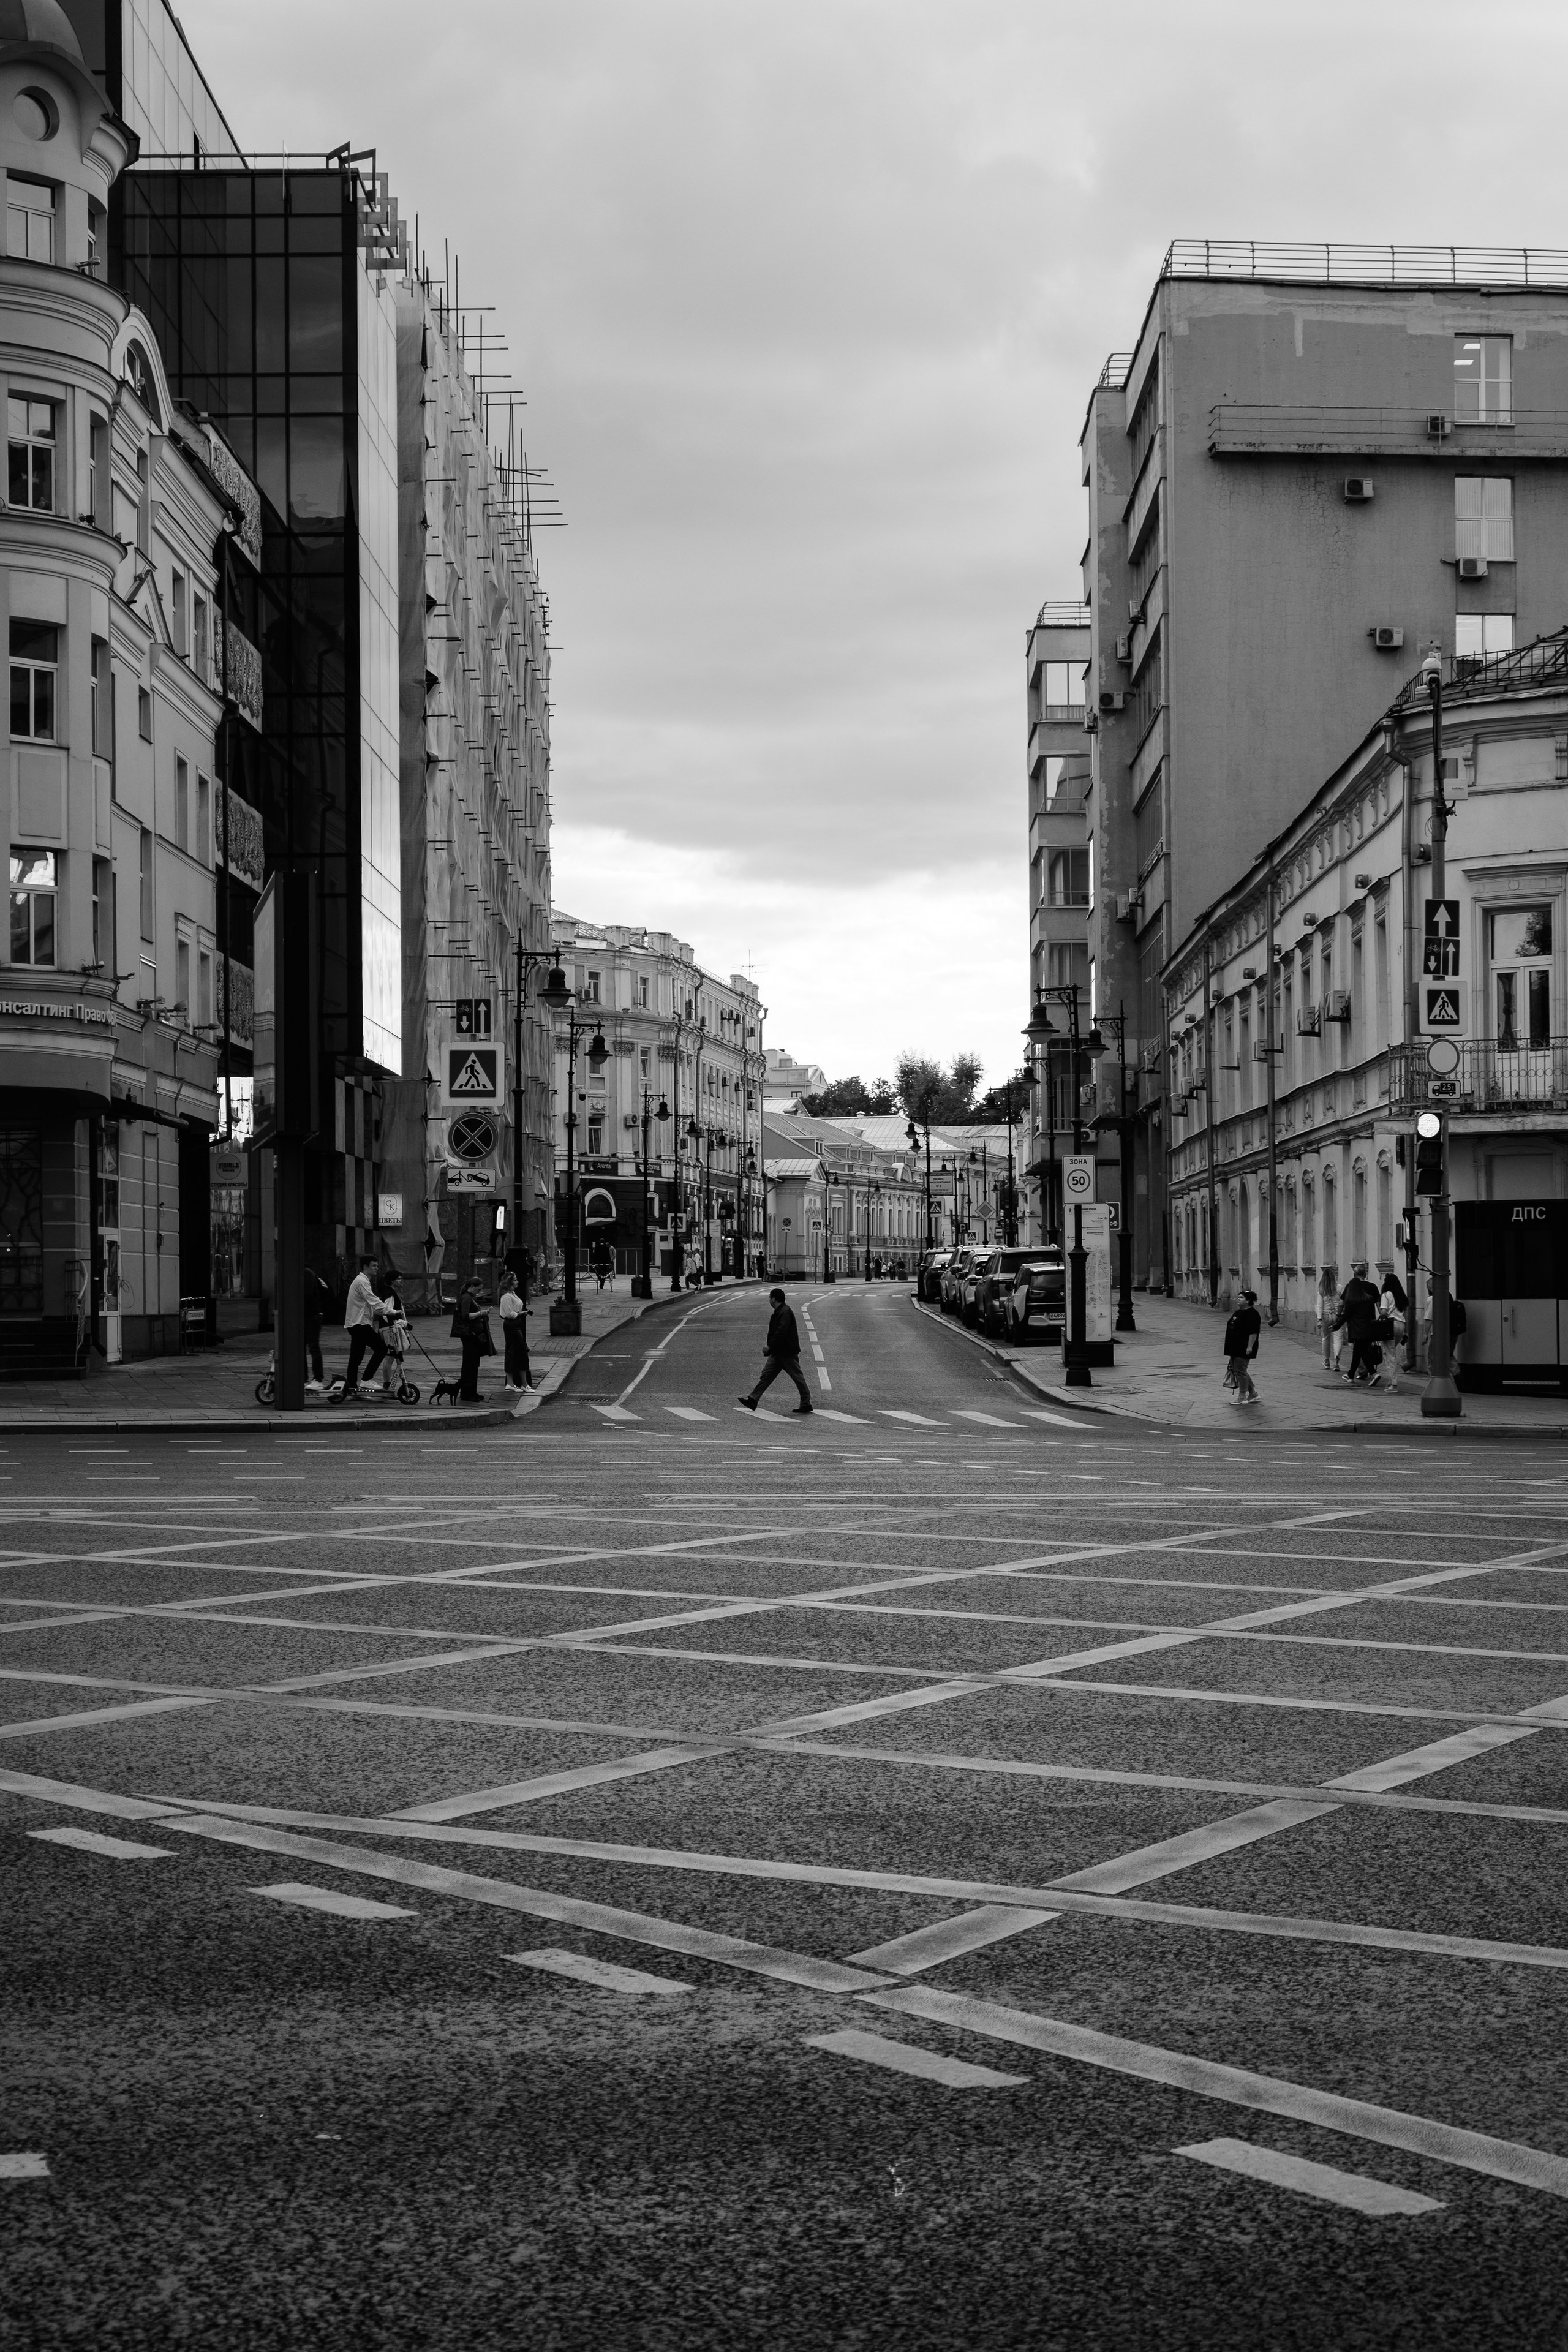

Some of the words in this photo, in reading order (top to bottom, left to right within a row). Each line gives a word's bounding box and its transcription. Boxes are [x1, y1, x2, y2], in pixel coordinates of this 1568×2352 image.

[0, 1001, 73, 1018] нсалтинг
[74, 1003, 106, 1023] Право
[1072, 1176, 1085, 1186] 50
[1512, 1207, 1546, 1222] ДПС
[960, 1224, 966, 1233] P
